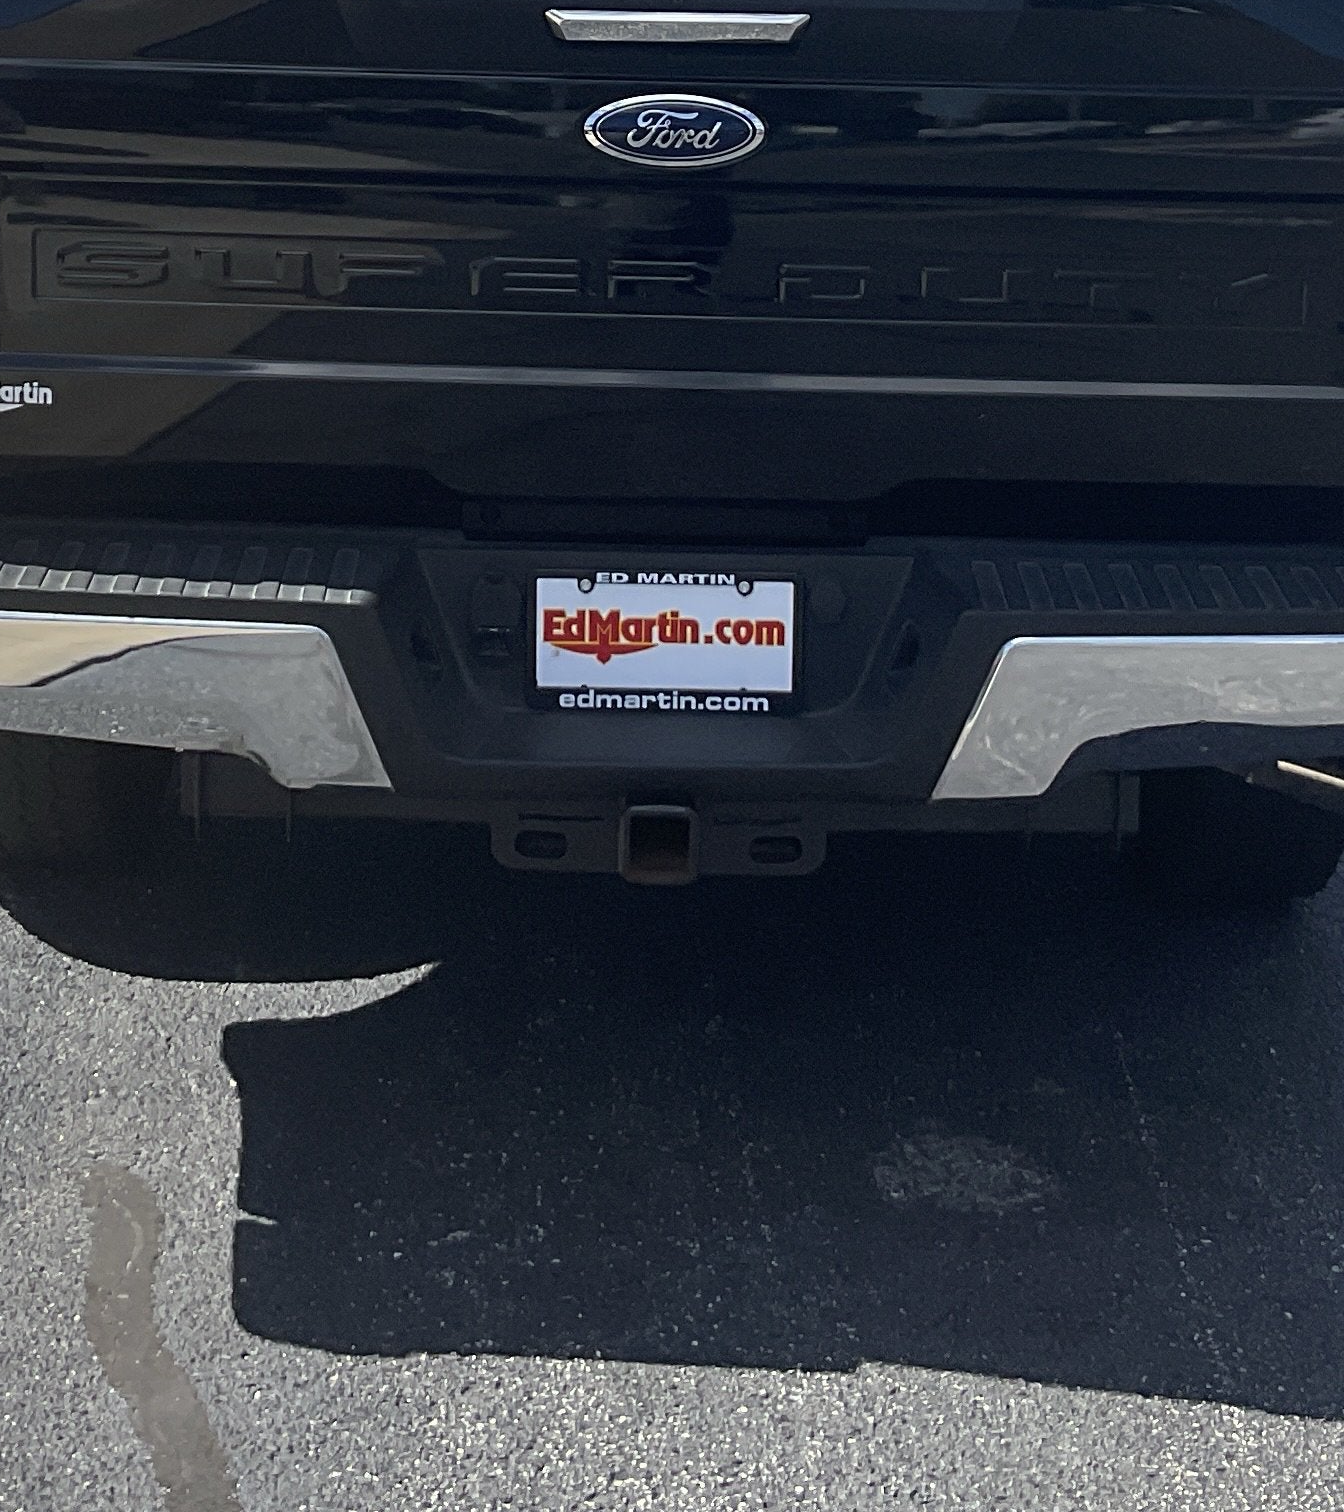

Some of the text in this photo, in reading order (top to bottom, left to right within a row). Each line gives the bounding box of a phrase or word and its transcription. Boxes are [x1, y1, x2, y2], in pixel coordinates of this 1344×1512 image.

[626, 109, 723, 150] Ford
[595, 571, 736, 586] ED MARTIN
[543, 608, 786, 647] EdMartin.com
[558, 689, 770, 713] edmartin.com
